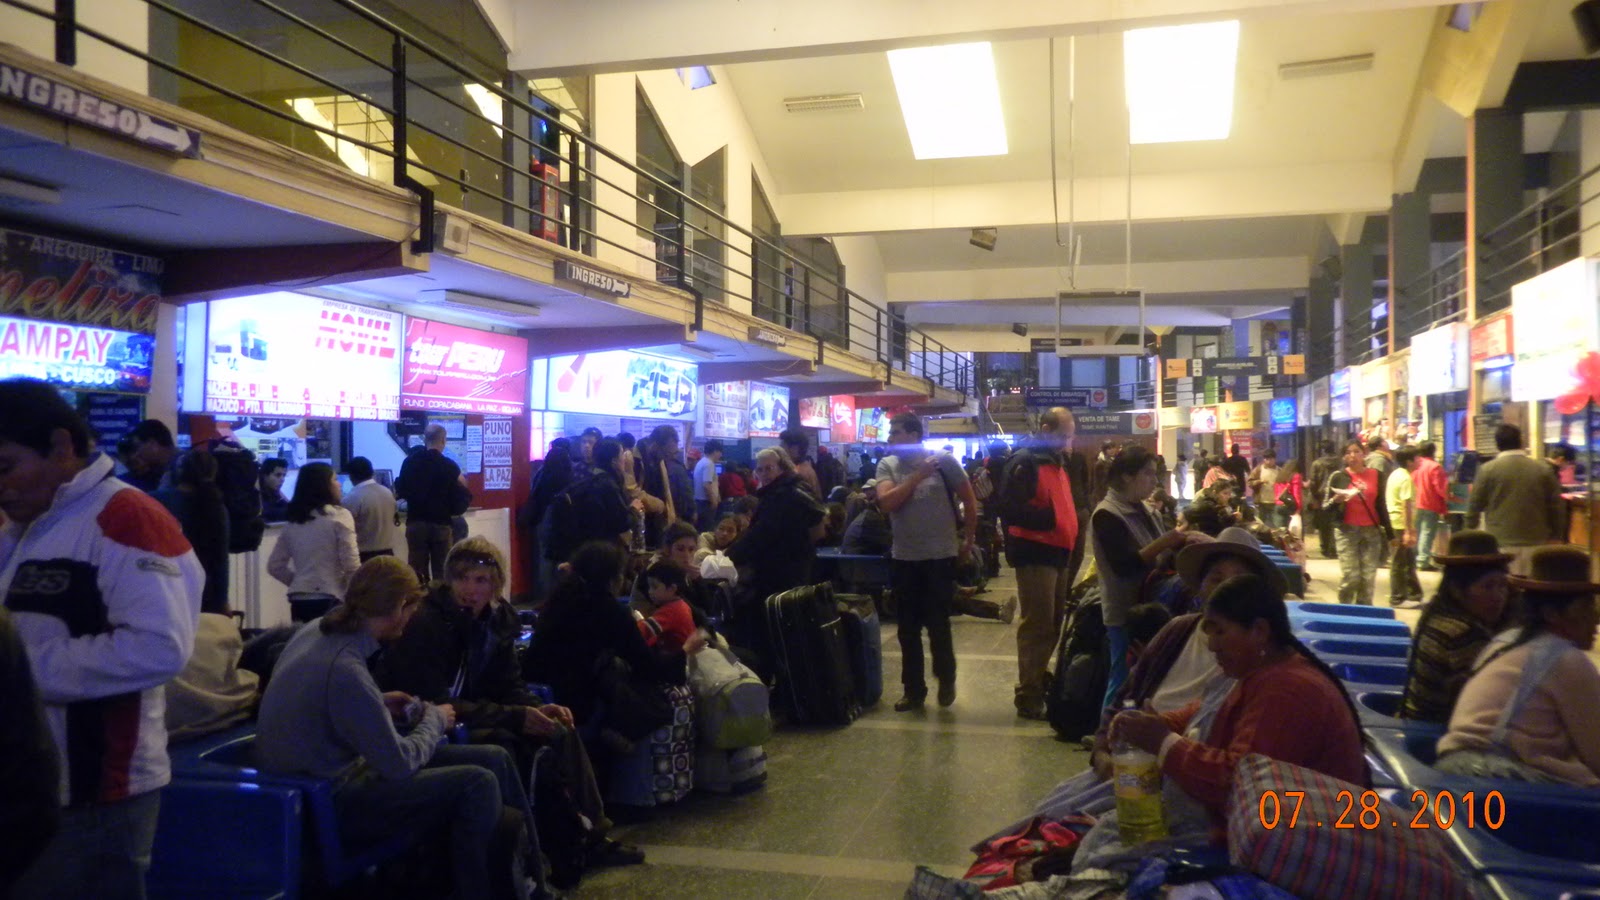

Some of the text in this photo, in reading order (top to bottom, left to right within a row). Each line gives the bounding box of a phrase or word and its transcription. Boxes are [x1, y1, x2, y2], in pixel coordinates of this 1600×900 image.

[30, 236, 114, 266] AREQUIPA
[572, 265, 613, 290] INGRESO
[61, 366, 116, 385] CUSCO
[403, 399, 425, 407] PUNO
[428, 400, 473, 410] COPACABANA
[485, 422, 511, 434] PUNO
[496, 468, 511, 482] PAZ
